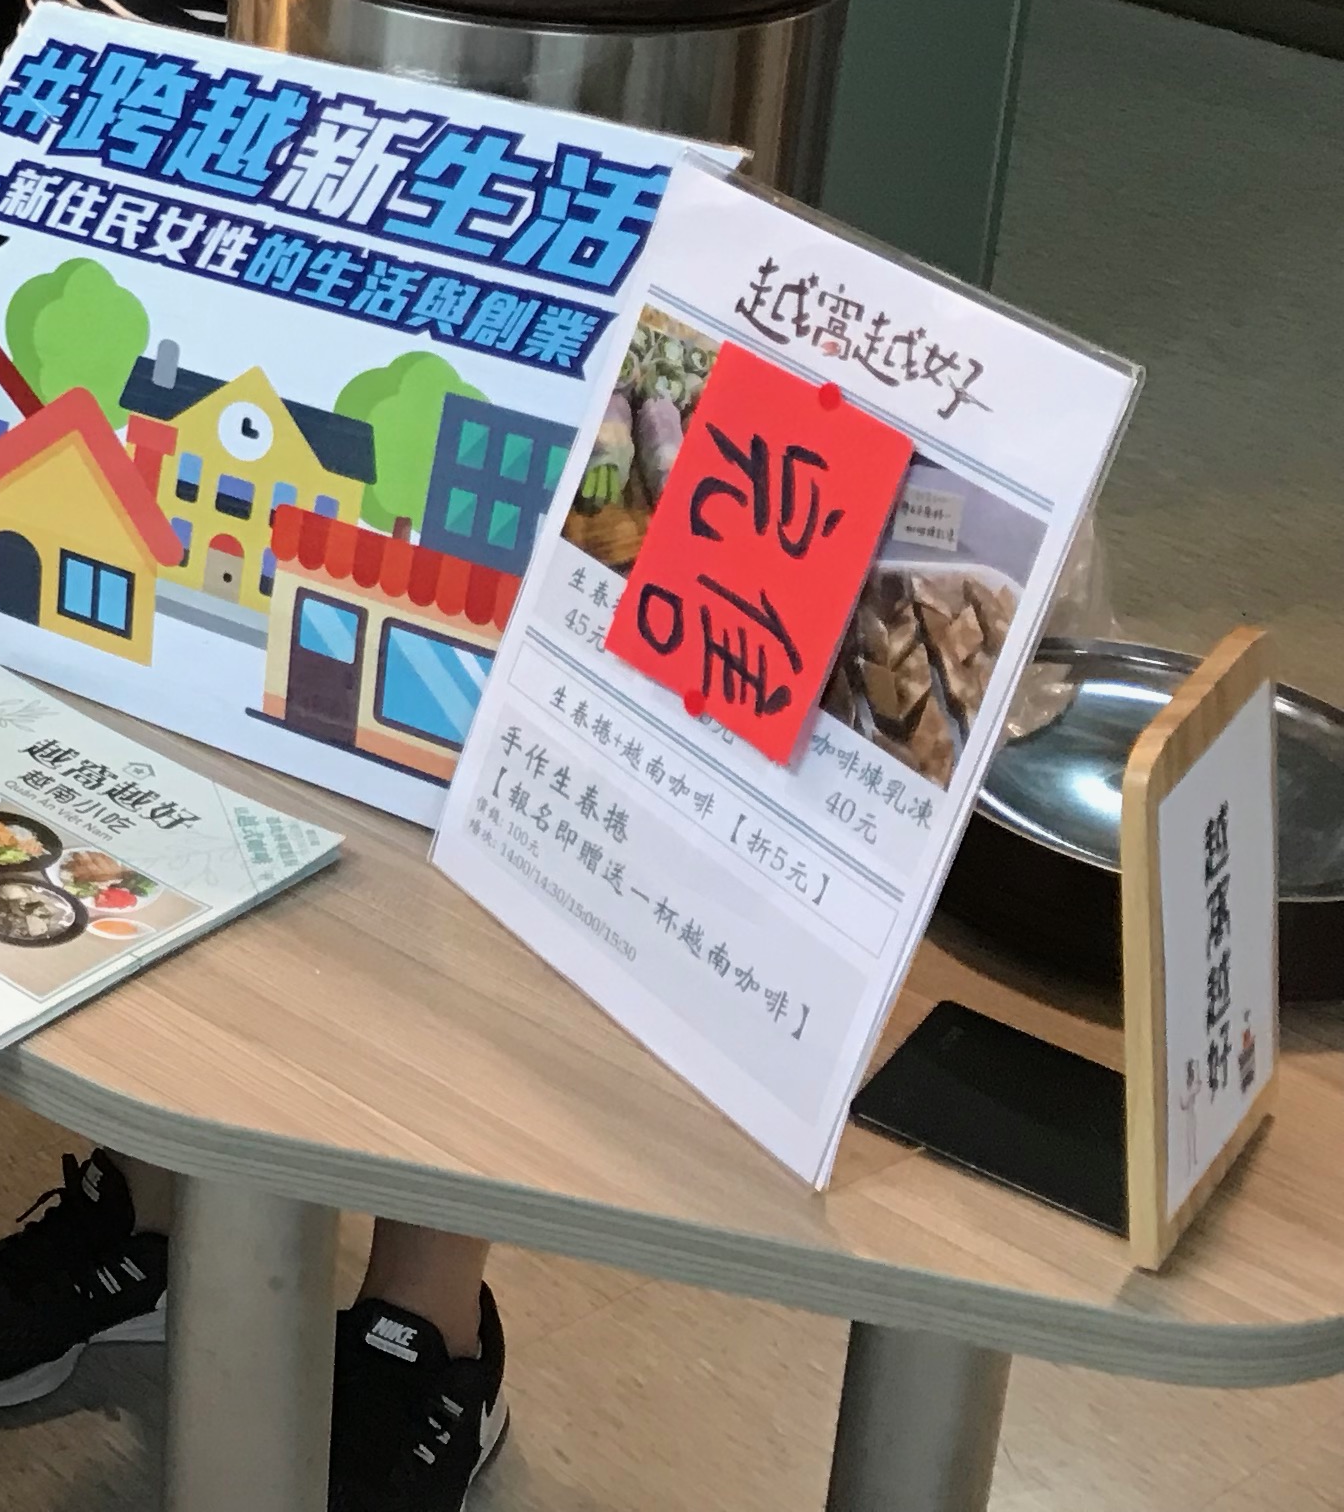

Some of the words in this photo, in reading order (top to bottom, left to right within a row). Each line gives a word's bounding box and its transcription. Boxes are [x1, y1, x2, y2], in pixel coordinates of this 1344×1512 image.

[568, 567, 619, 609] 生春
[637, 421, 845, 717] 完售
[16, 769, 137, 835] 越南小吃
[17, 738, 202, 830] 越窩越好
[501, 725, 631, 844] 手作生春捲
[82, 820, 115, 843] Nam
[823, 790, 880, 846] 40元
[372, 1316, 418, 1347] NIKE
